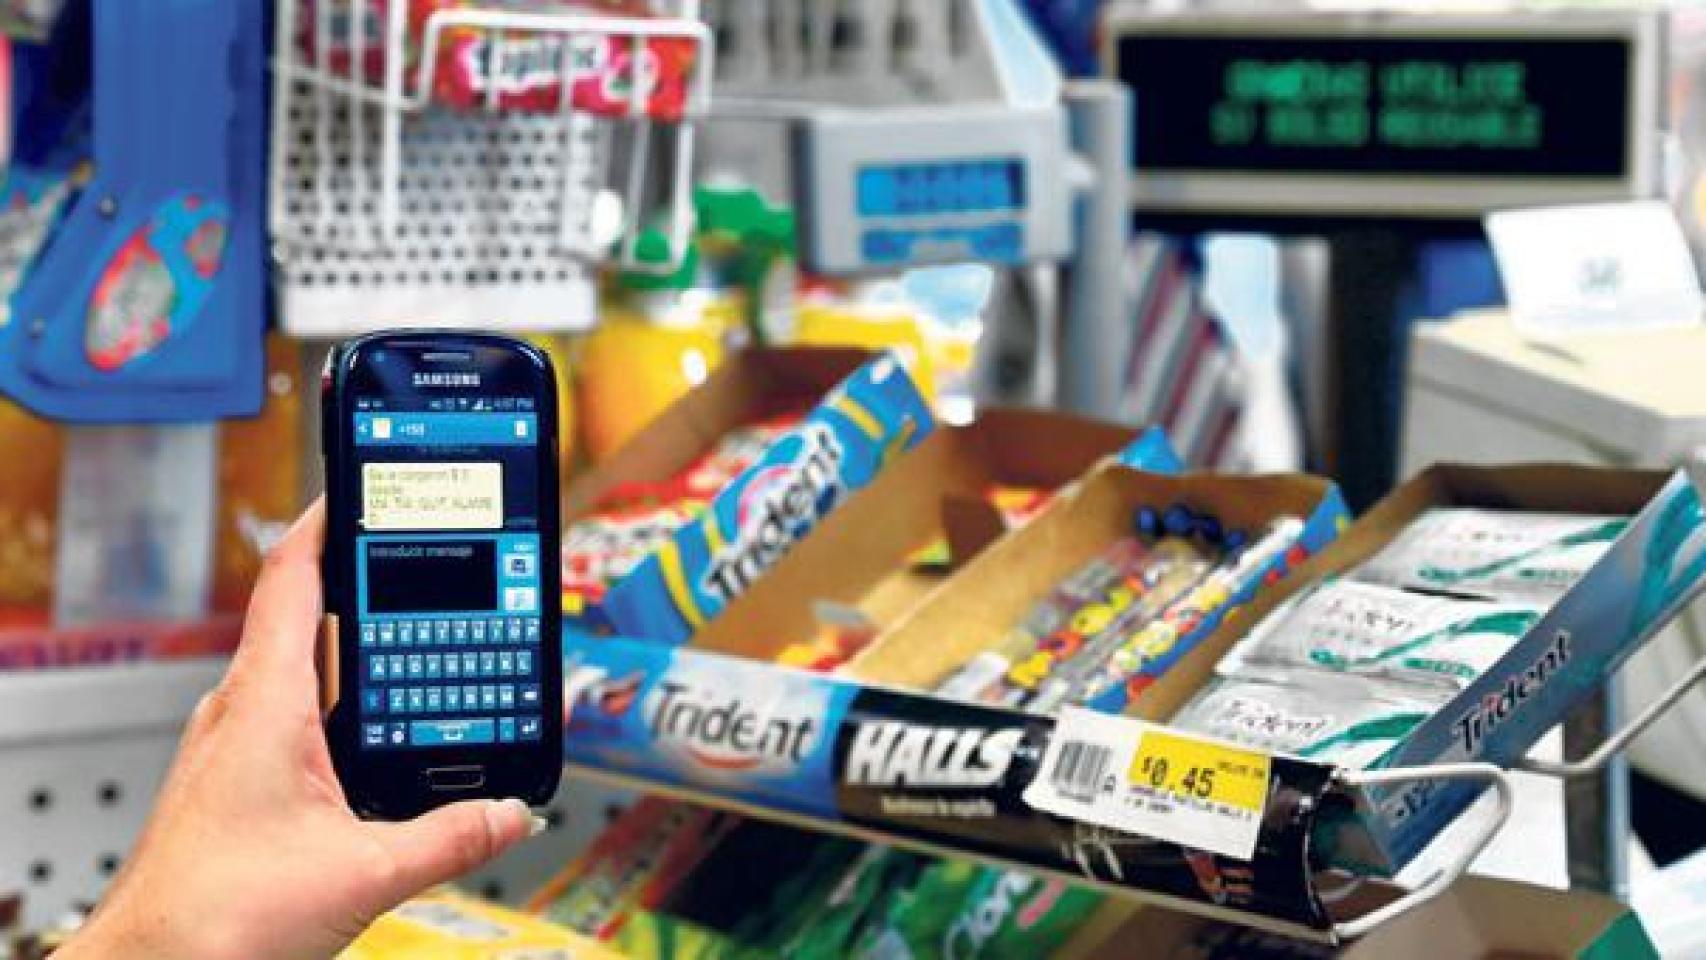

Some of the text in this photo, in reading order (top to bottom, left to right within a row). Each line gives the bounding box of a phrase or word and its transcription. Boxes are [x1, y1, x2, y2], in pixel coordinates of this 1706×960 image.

[413, 372, 481, 387] SAMSUNG
[704, 430, 839, 598] Trident
[652, 682, 814, 761] Trident
[1454, 634, 1571, 752] Trident
[845, 724, 1024, 785] HALLS
